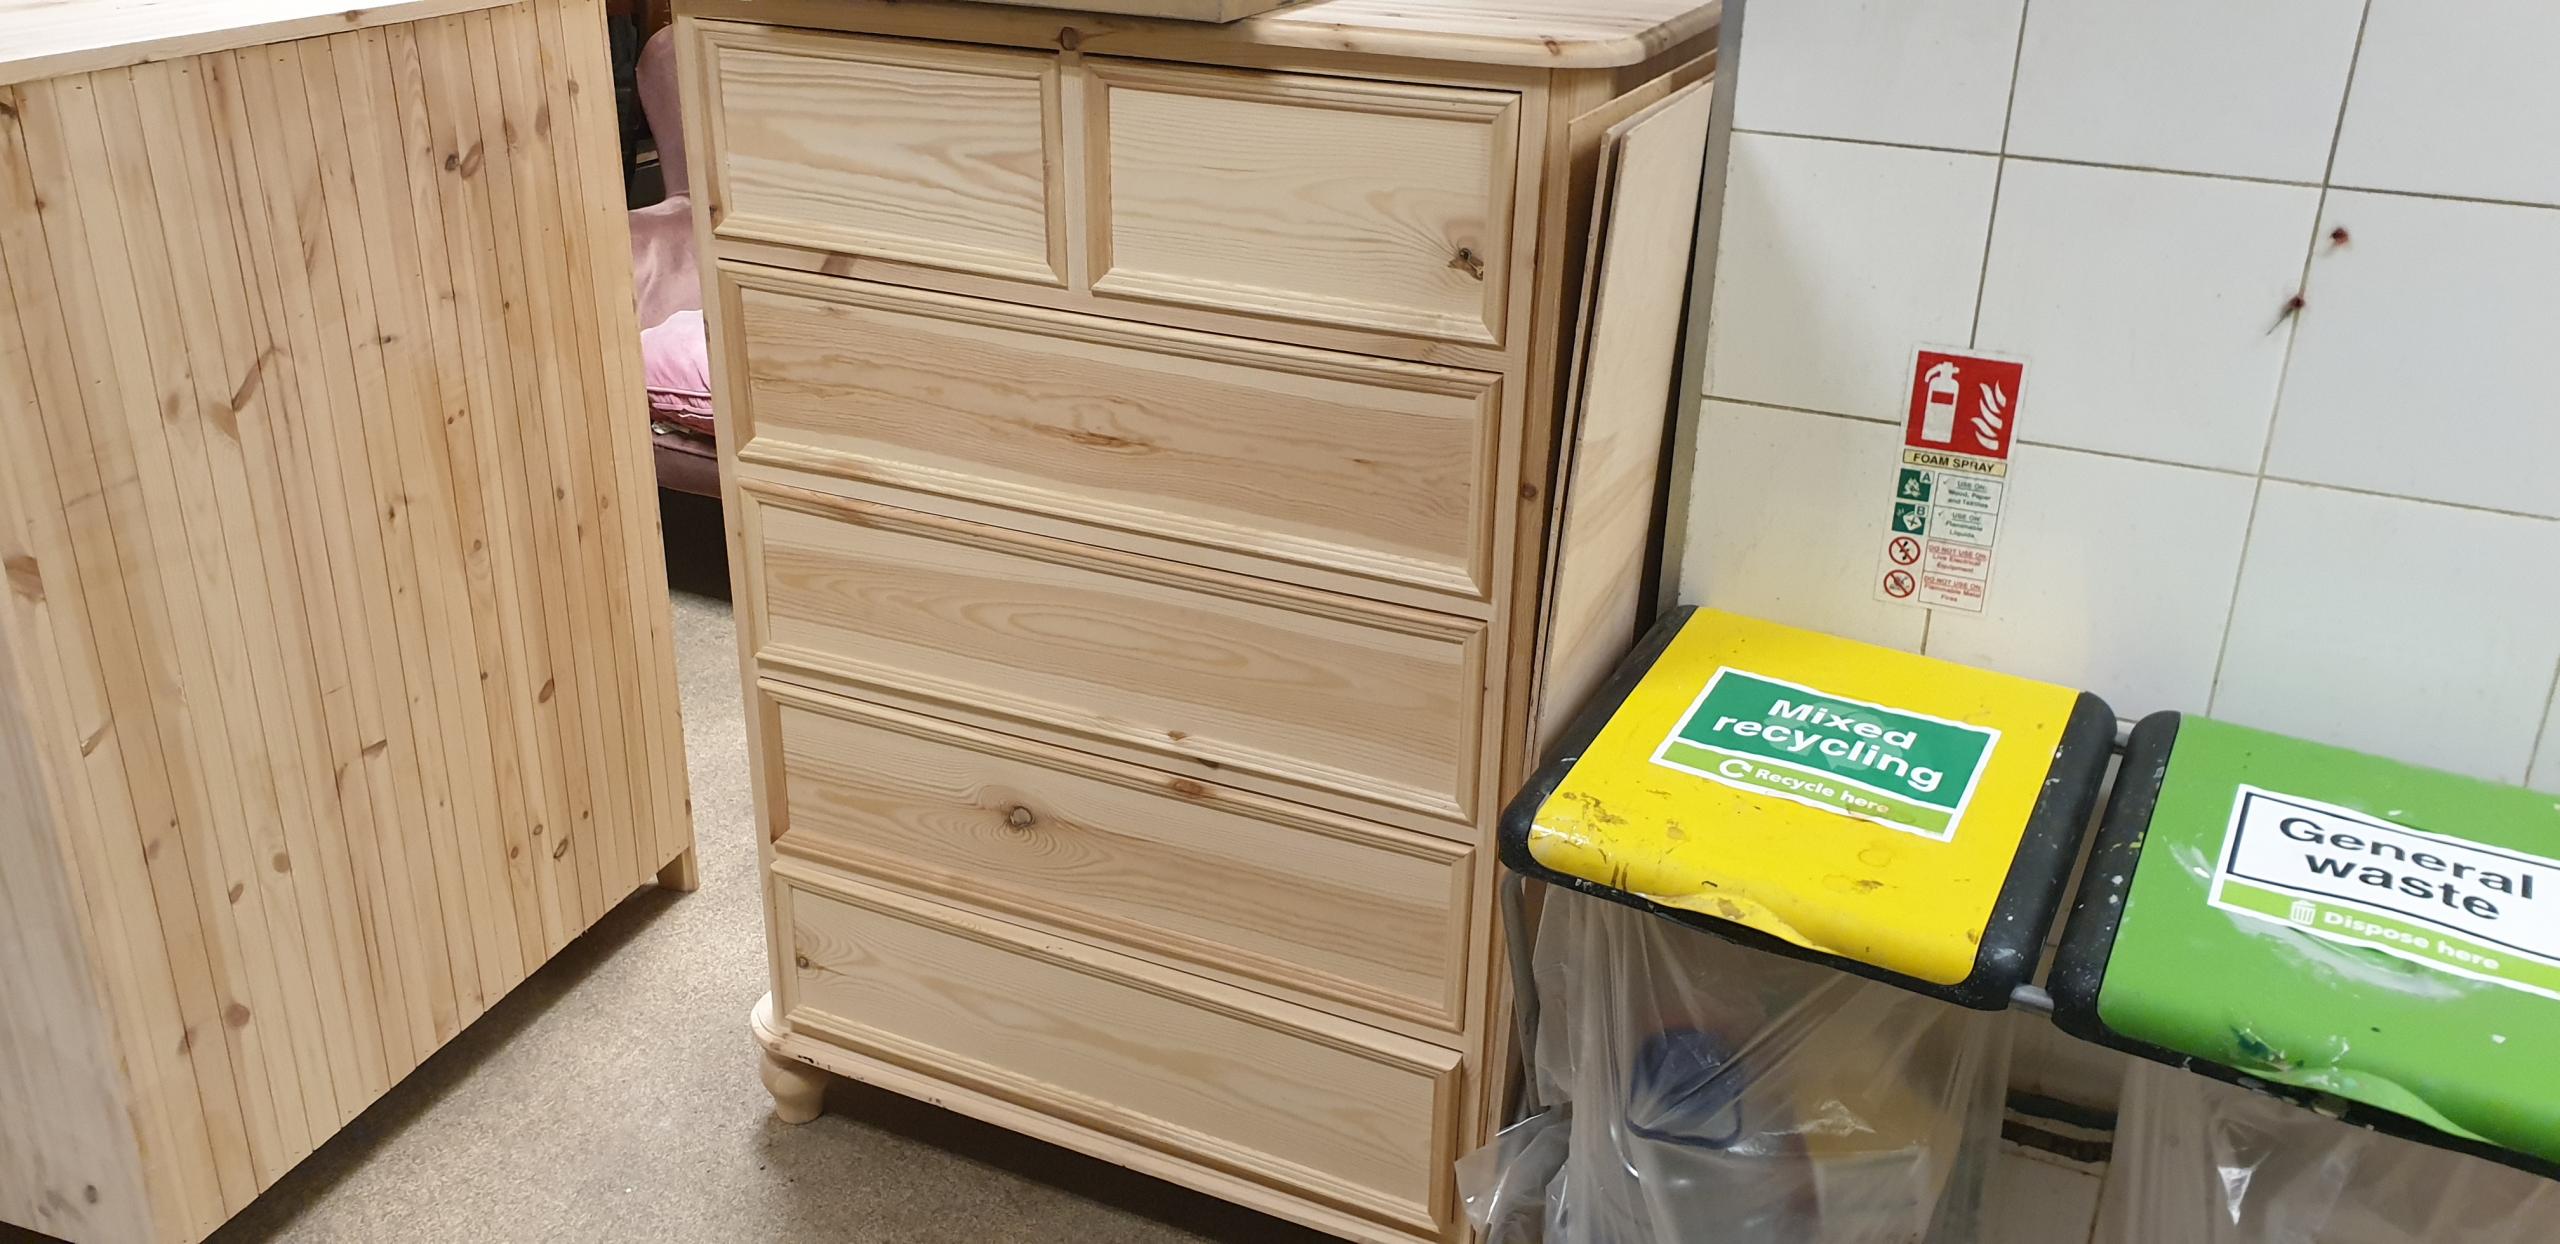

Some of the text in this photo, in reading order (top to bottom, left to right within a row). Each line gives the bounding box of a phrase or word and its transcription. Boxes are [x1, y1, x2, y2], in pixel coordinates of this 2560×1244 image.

[1913, 453, 1995, 472] FOAM SPRAY
[1922, 472, 1931, 482] A
[1957, 481, 1971, 489] USE
[1971, 493, 1991, 502] Paper
[1917, 506, 1926, 516] B
[1952, 512, 1967, 520] USE
[1768, 699, 1918, 750] Mixed
[1712, 715, 1944, 793] recycling
[1754, 768, 1890, 814] Recycle here
[2279, 817, 2534, 900] General
[2305, 854, 2500, 920] waste
[2323, 910, 2500, 970] Dispose here
